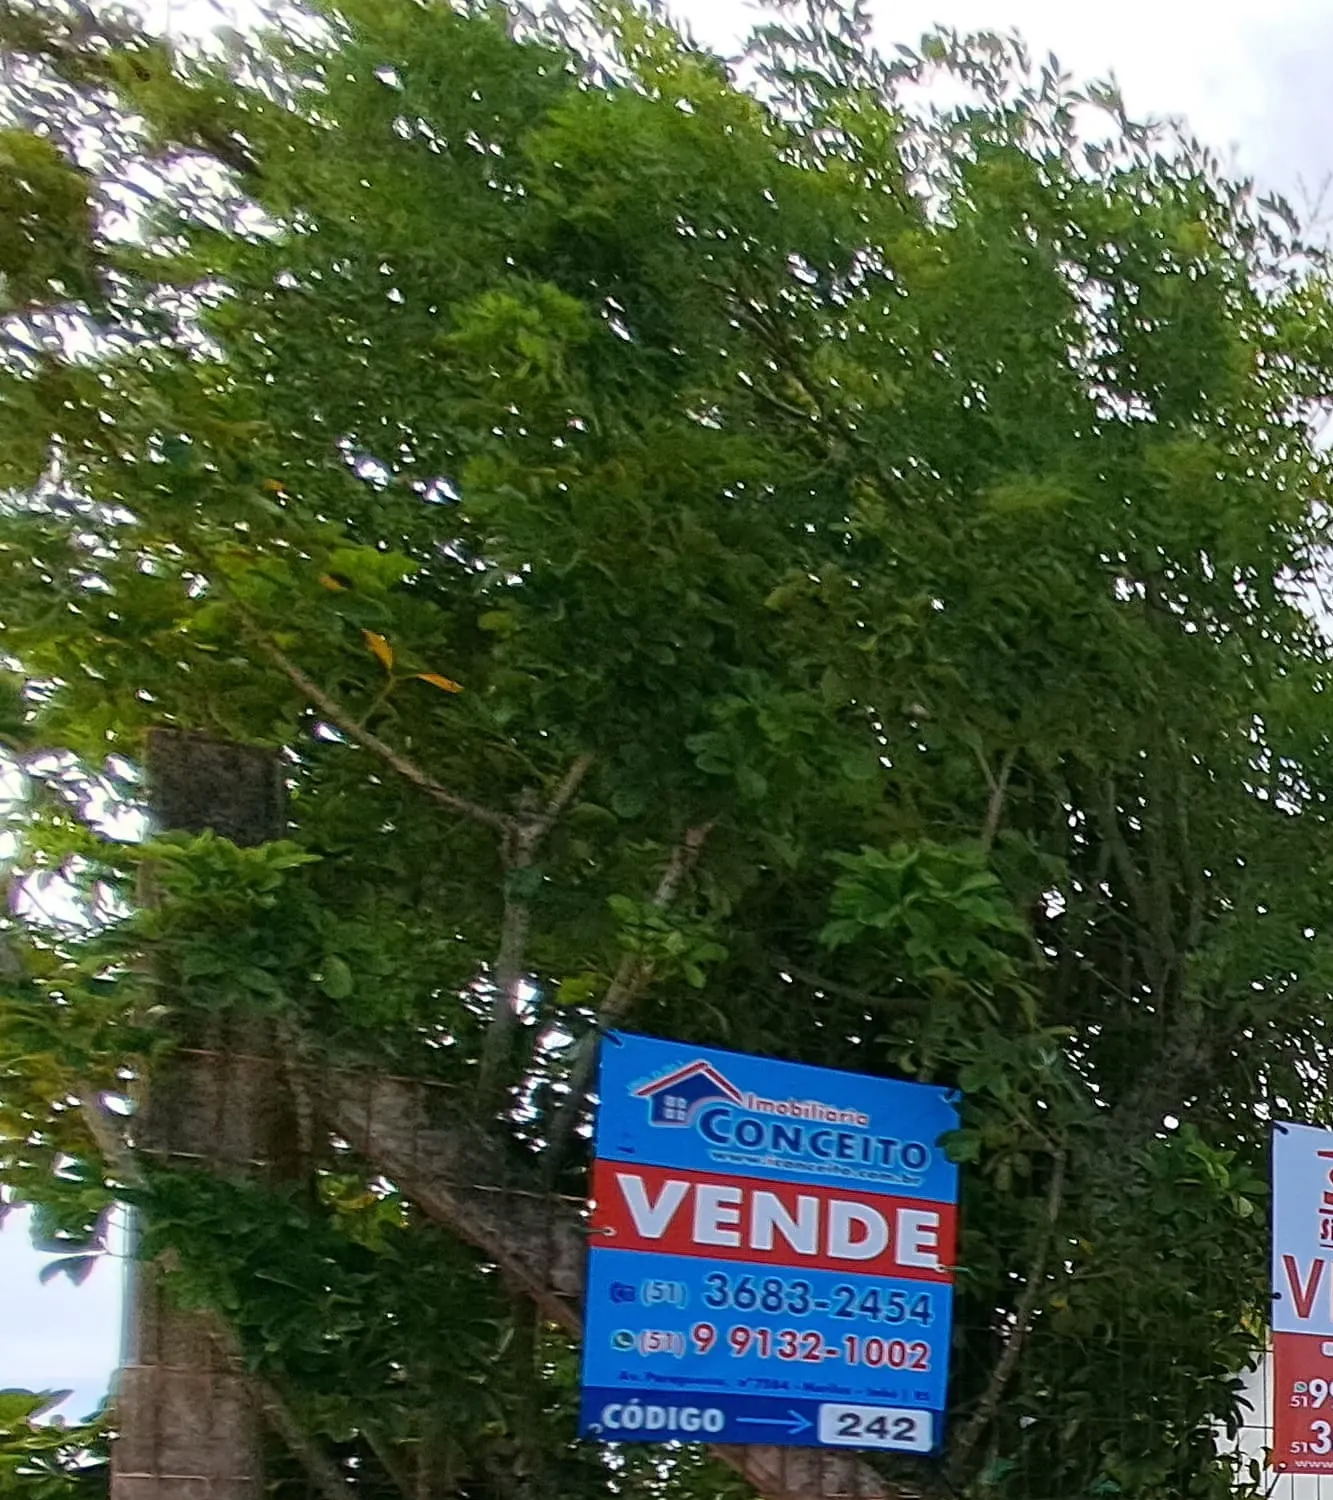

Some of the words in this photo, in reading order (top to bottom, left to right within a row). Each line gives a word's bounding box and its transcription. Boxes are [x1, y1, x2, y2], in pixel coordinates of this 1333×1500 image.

[699, 1106, 928, 1170] CONCEITO
[615, 1172, 939, 1269] VENDE
[642, 1279, 687, 1308] (51)
[704, 1273, 932, 1326] 3683-2454
[640, 1330, 684, 1357] (51)
[692, 1322, 715, 1353] 9
[728, 1326, 930, 1370] 9132-1002
[602, 1398, 724, 1433] CÓDIGO
[836, 1411, 917, 1442] 242
